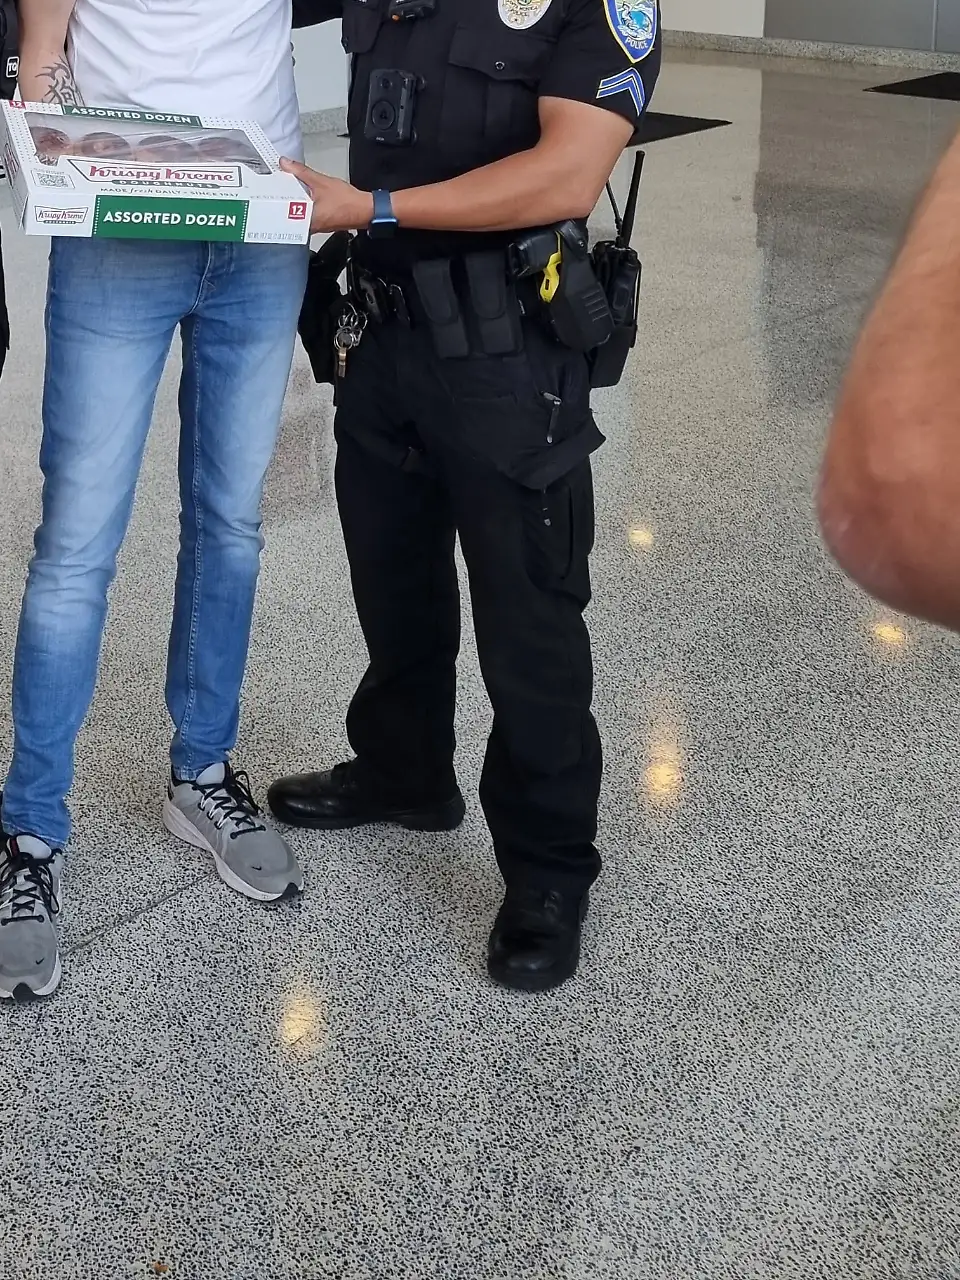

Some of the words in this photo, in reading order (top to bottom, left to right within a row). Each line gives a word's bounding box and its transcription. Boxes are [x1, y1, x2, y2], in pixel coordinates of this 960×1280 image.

[624, 37, 649, 49] POLICE
[71, 107, 141, 119] ASSORTED
[144, 113, 192, 123] DOZEN
[90, 165, 162, 180] Krispy
[165, 168, 234, 182] Kreme
[103, 210, 181, 225] ASSORTED
[185, 214, 236, 227] DOZEN
[291, 205, 304, 216] 12
